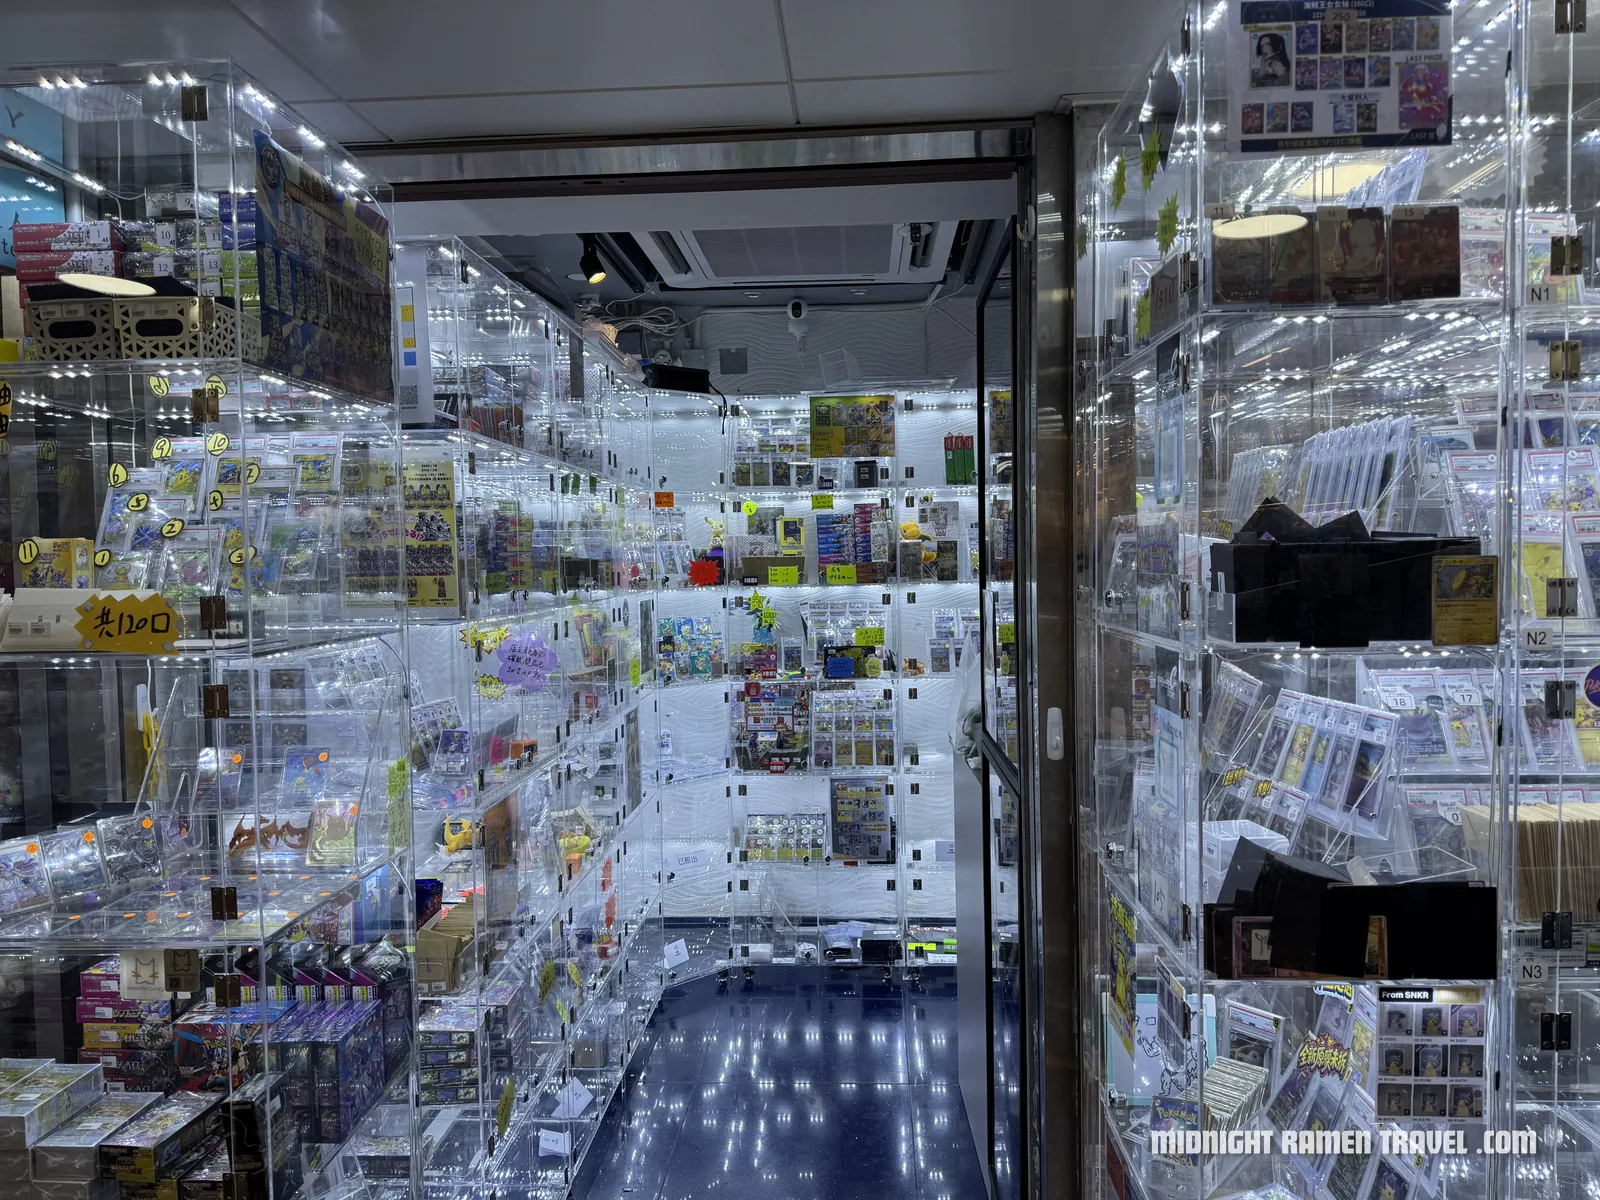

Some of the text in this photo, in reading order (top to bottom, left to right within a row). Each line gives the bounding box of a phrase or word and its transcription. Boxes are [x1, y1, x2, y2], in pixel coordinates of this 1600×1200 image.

[1332, 12, 1351, 22] 250
[184, 197, 191, 206] 9
[1214, 207, 1225, 216] 11
[1327, 209, 1337, 218] 14
[1402, 208, 1415, 217] 15
[160, 230, 171, 240] 10
[98, 257, 104, 267] 2
[208, 260, 219, 270] 13
[158, 263, 169, 272] 12
[1531, 287, 1549, 301] N1
[213, 437, 224, 450] 10
[110, 465, 121, 485] 6
[131, 494, 146, 508] 5
[209, 493, 222, 507] 4
[165, 521, 178, 534] 2
[23, 543, 34, 560] 11
[94, 605, 171, 638] 共120口
[1527, 631, 1547, 645] N2
[1393, 697, 1407, 707] 18
[1460, 694, 1473, 703] 17
[1522, 965, 1542, 979] N3
[1381, 990, 1404, 999] From
[1404, 991, 1429, 1000] SNKR
